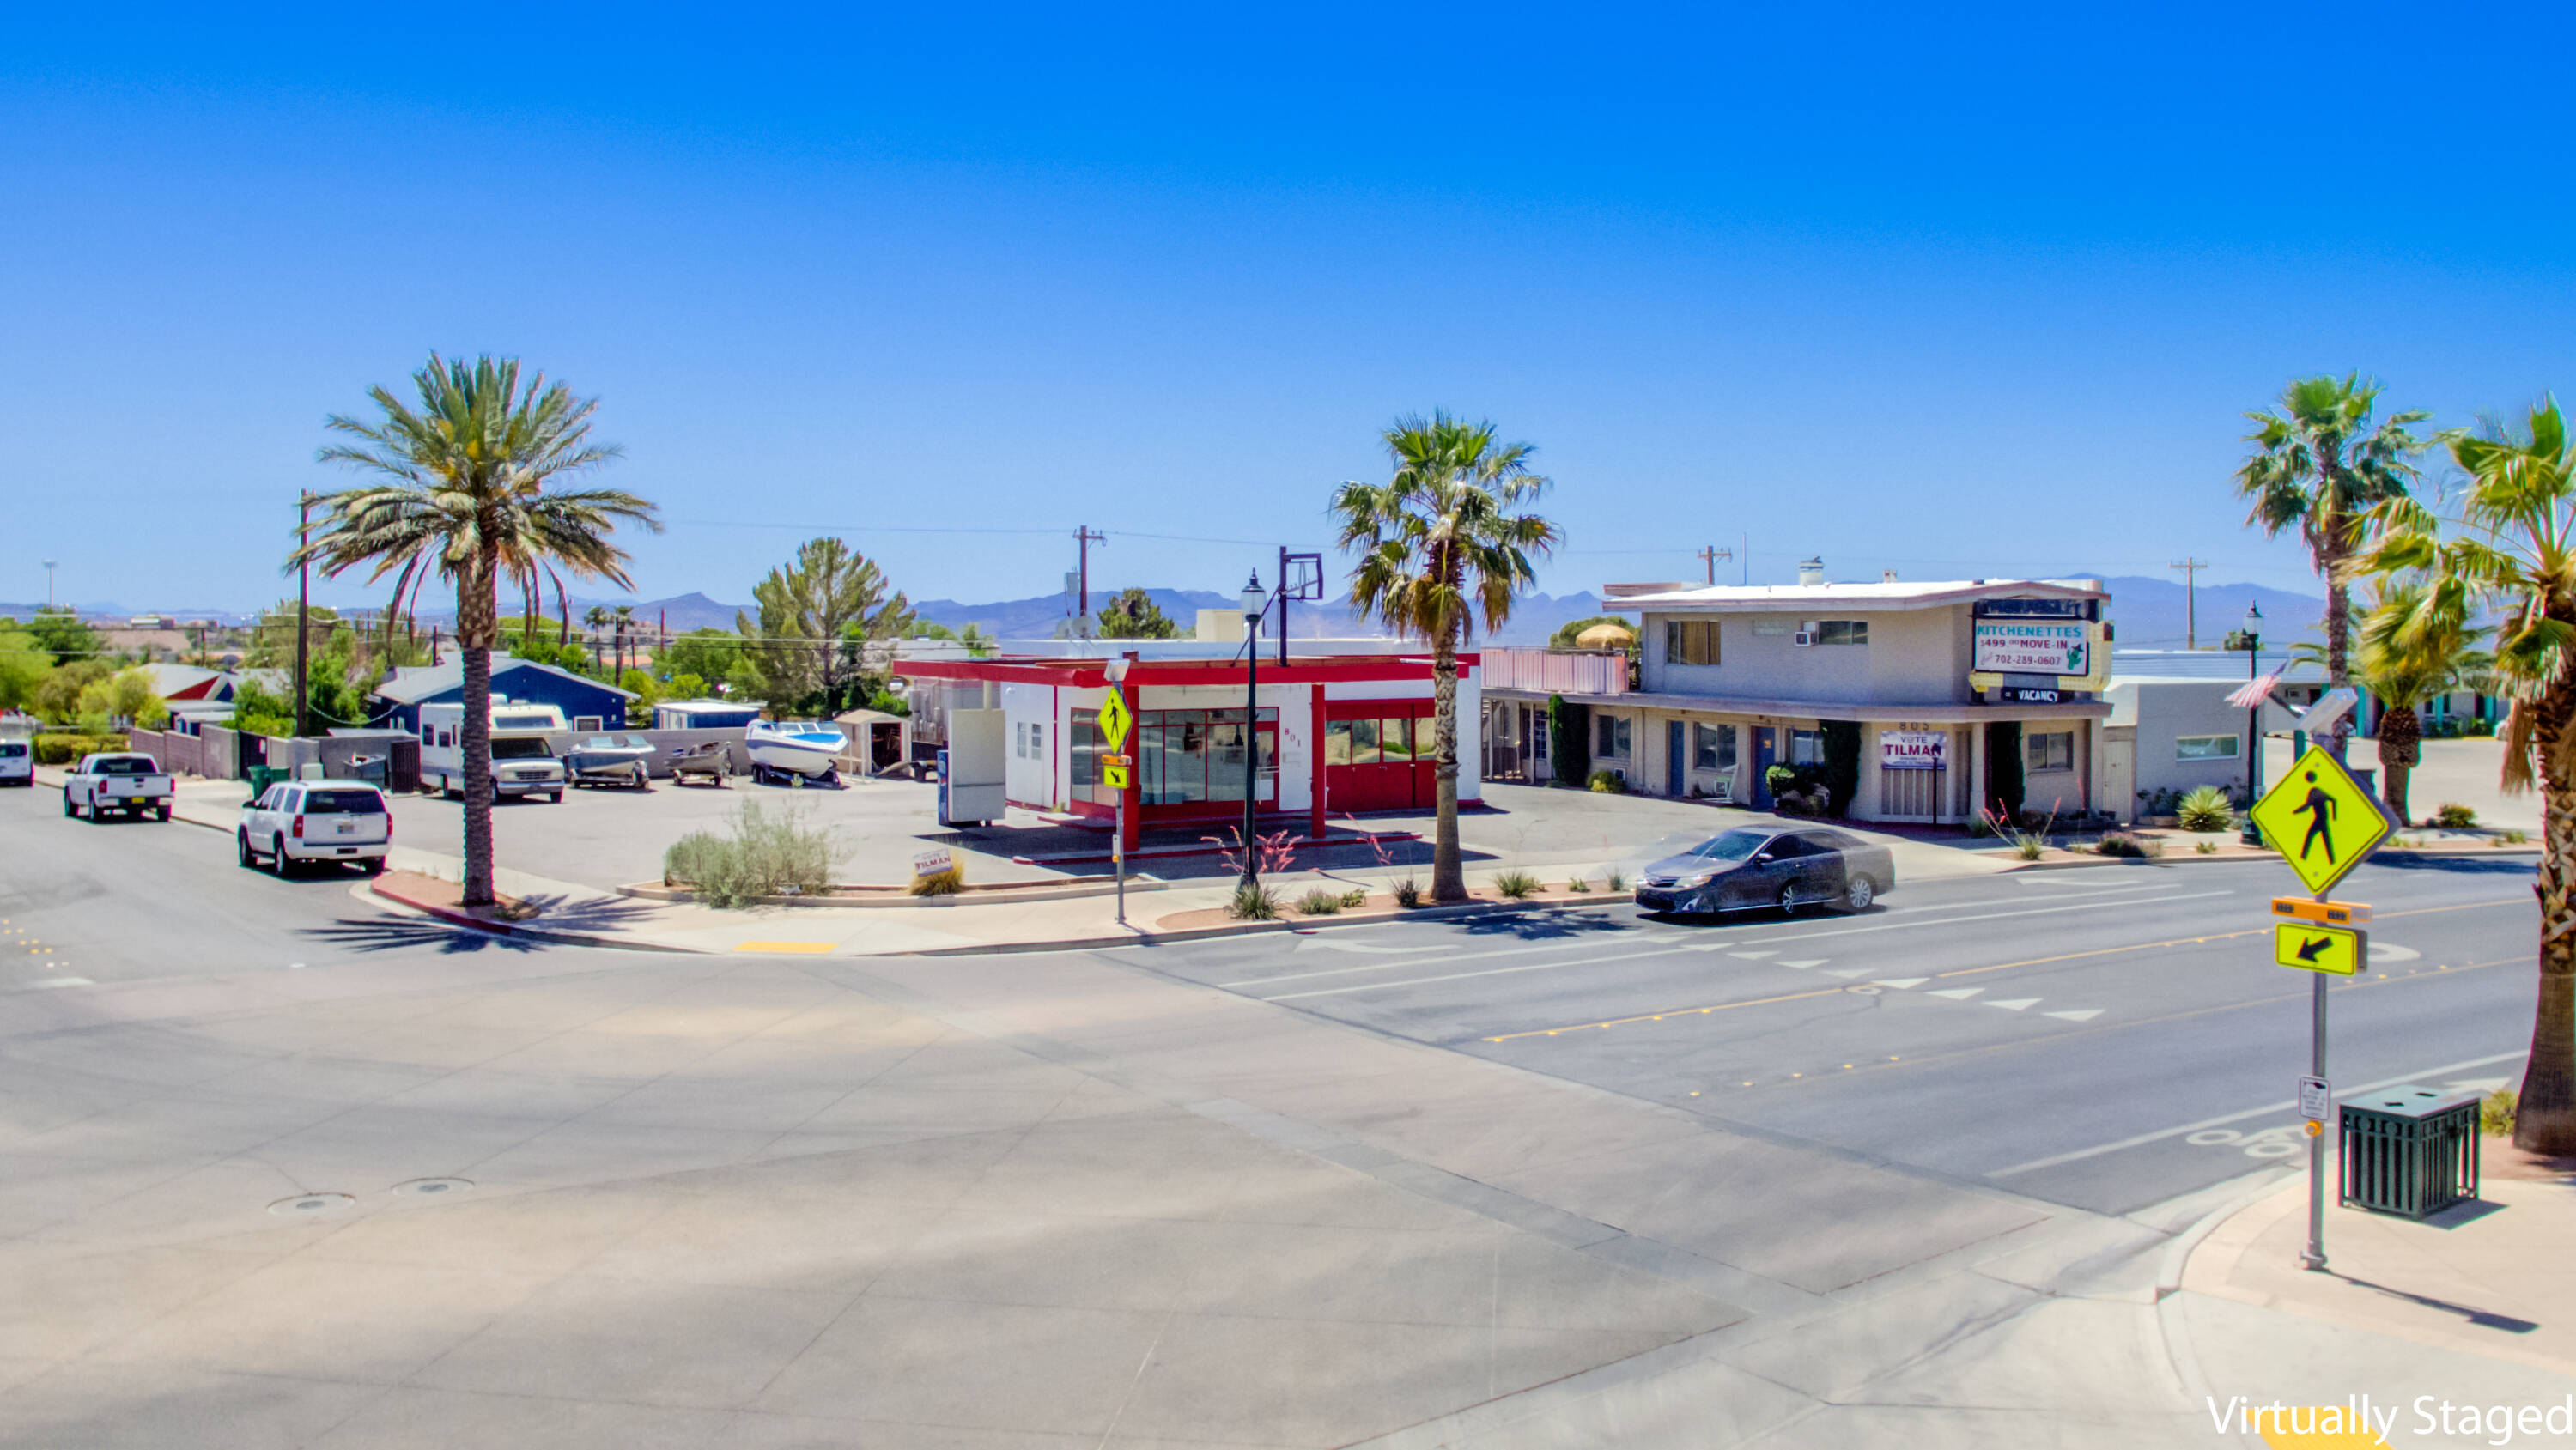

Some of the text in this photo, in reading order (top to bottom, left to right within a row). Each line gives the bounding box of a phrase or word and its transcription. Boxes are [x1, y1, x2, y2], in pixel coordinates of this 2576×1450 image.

[1977, 625, 2082, 638] KITCHENETTES
[2020, 639, 2068, 650] MOVE-IN
[1995, 654, 2061, 666] 702-289-0607
[2019, 689, 2059, 702] VACANCY
[1899, 722, 1930, 731] 805
[1285, 728, 1300, 747] 801
[1883, 743, 1942, 756] TILMAN
[914, 857, 951, 869] TILMAN
